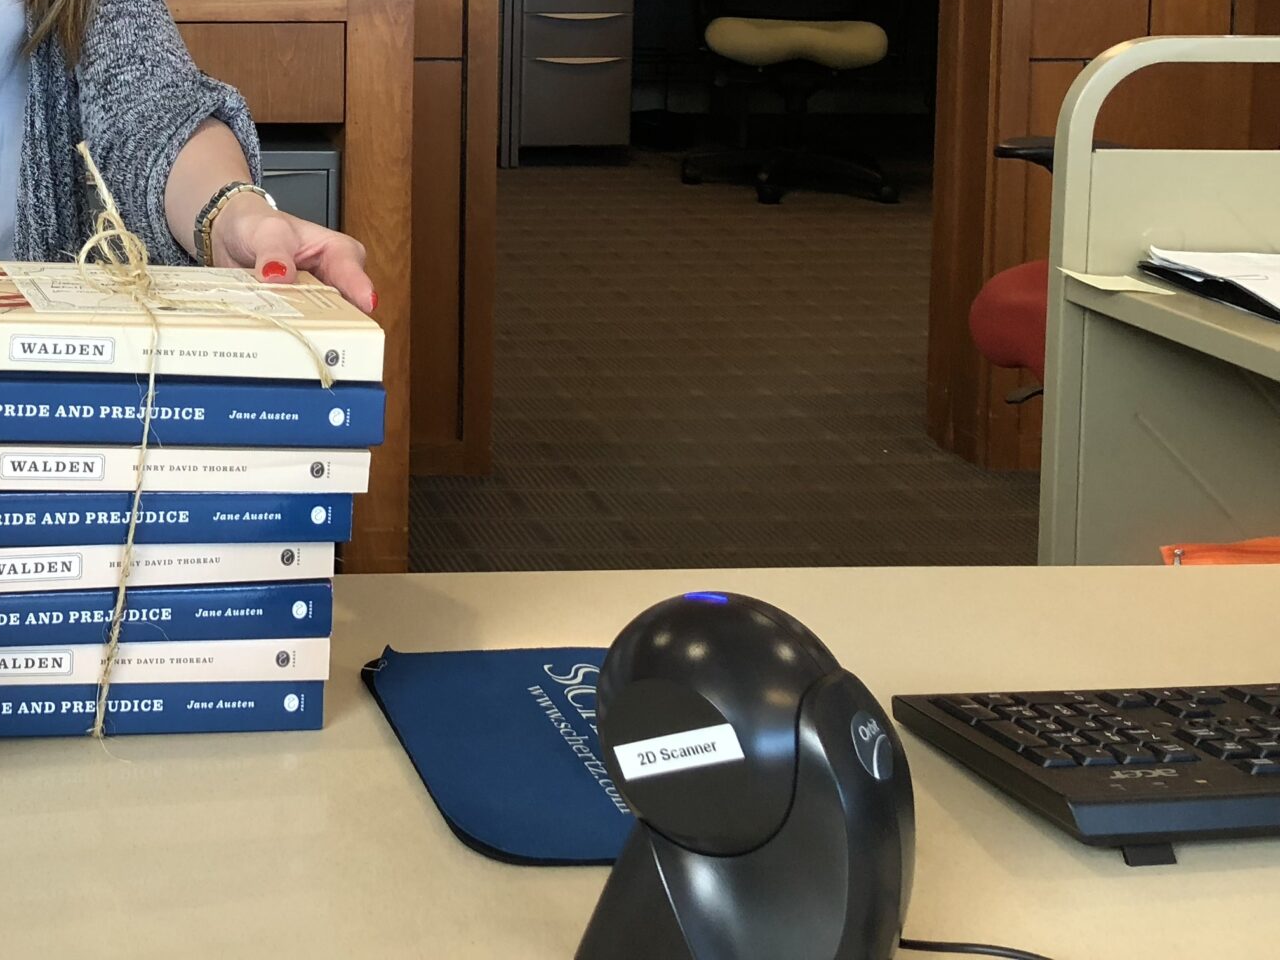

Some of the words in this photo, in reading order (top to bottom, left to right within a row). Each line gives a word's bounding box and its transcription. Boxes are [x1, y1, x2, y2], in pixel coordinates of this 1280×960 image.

[20, 342, 105, 356] WALDEN
[179, 349, 209, 357] DAVID
[212, 350, 258, 359] THOREAU
[54, 405, 95, 418] AND
[228, 410, 257, 420] Jane
[257, 410, 299, 421] Austen
[10, 460, 95, 473] WALDEN
[168, 464, 199, 472] DAVID
[41, 512, 80, 525] AND
[212, 511, 241, 521] Jane
[242, 511, 282, 521] Austen
[144, 559, 174, 567] DAVID
[176, 556, 221, 565] THOREAU
[24, 611, 64, 625] AND
[194, 608, 222, 618] Jane
[222, 607, 263, 617] Austen
[100, 657, 132, 666] HNRY
[136, 657, 166, 665] DAVID
[169, 657, 214, 665] THOREAU
[17, 701, 56, 714] AND
[60, 699, 164, 715] PREUDICE
[186, 700, 219, 710] Jane
[217, 699, 255, 709] Austen
[527, 685, 631, 815] www.schertz.com
[636, 750, 657, 766] 2D
[659, 741, 718, 761] Scanner
